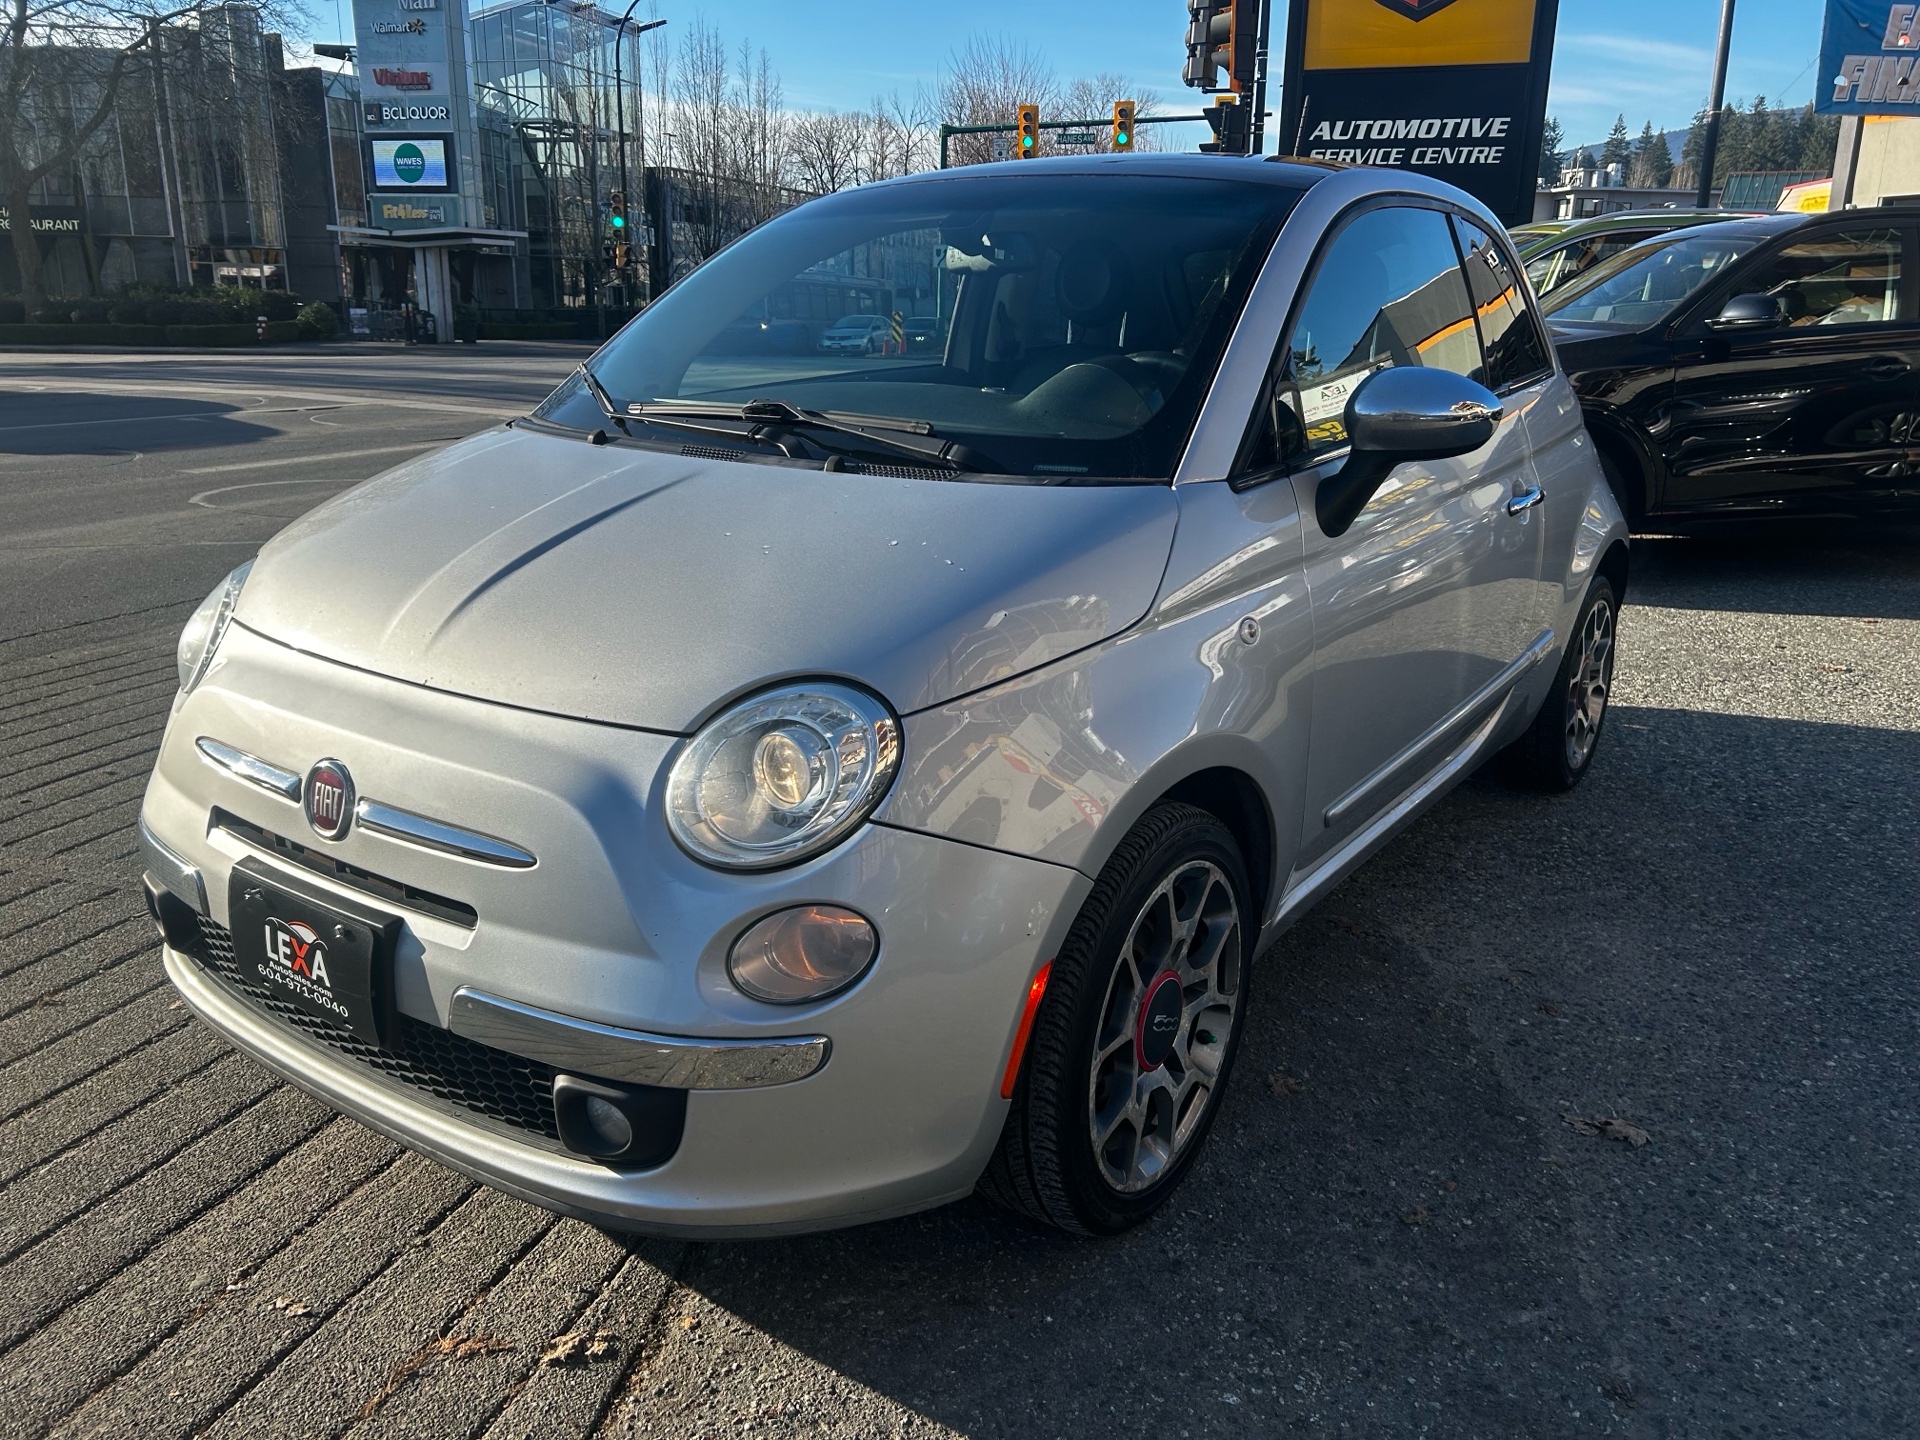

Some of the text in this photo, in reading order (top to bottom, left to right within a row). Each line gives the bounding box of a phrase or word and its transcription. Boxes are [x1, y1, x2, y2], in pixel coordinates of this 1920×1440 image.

[370, 21, 410, 33] Walmart
[1309, 117, 1511, 141] AUTOMOTIVE
[396, 157, 422, 166] WAVES
[1310, 146, 1505, 165] SERVICE CENTRE
[0, 219, 80, 231] REAURANT
[313, 782, 342, 821] FIAT
[265, 924, 331, 988] LEXA
[257, 963, 349, 1018] 604-971-0040
[269, 960, 333, 999] AutoSales.com
